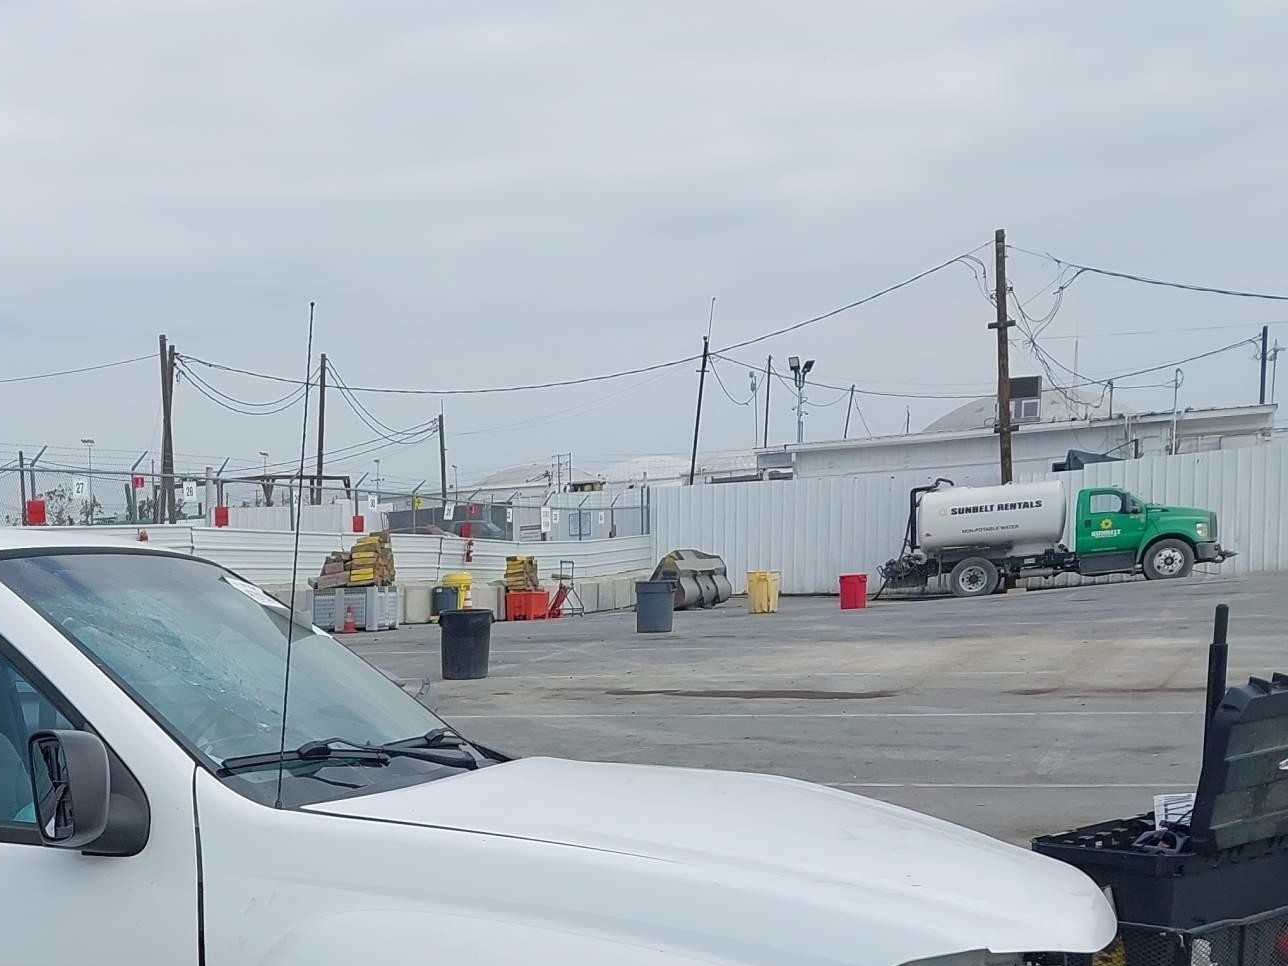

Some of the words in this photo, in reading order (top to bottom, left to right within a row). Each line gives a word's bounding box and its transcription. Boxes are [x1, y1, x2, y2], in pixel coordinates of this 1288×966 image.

[76, 482, 84, 494] 27
[951, 504, 995, 515] SUNBELT
[997, 500, 1042, 511] RENTALS
